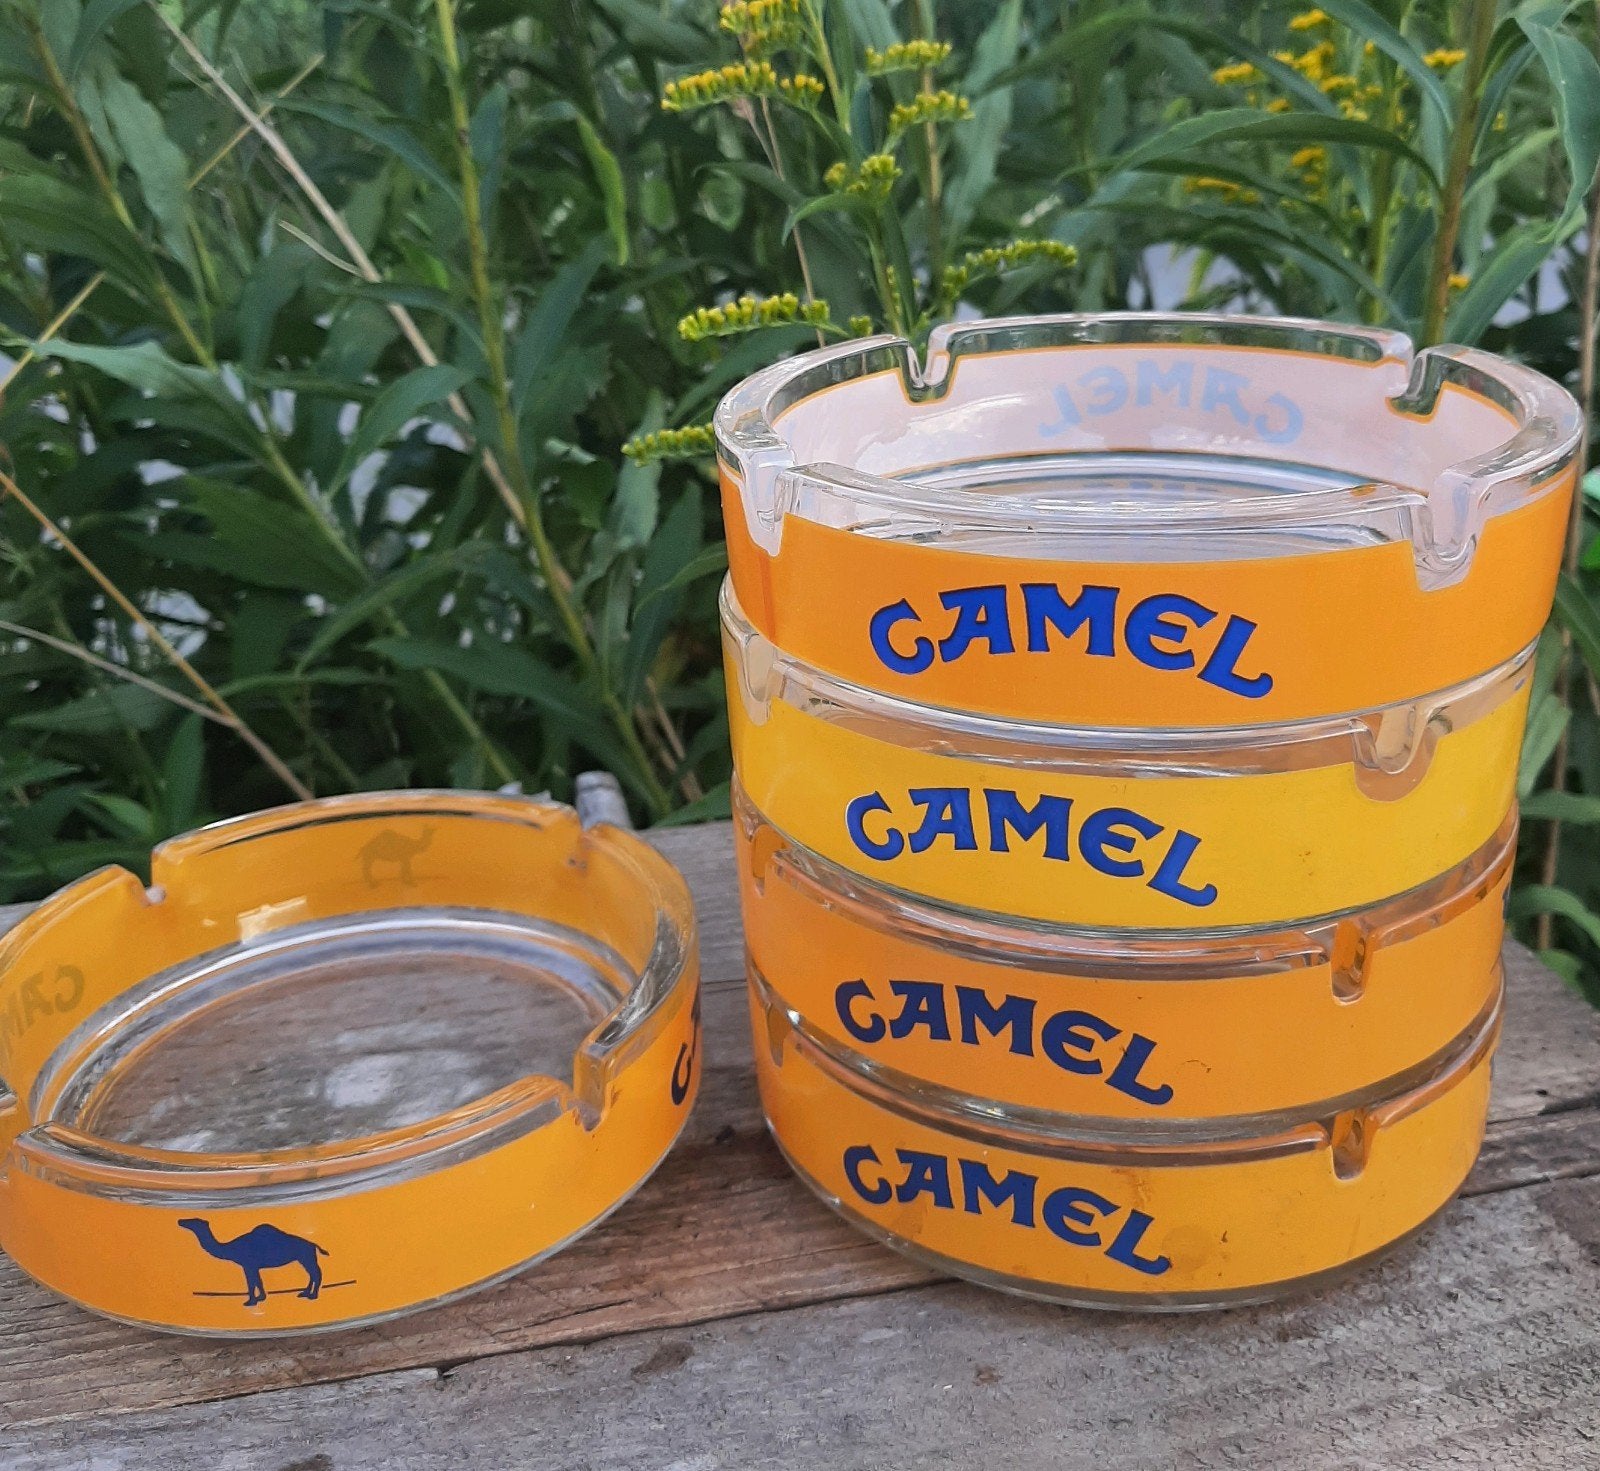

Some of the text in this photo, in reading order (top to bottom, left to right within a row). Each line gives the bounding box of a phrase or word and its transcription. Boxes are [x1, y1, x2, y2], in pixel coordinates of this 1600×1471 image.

[870, 584, 1273, 698] CAMEL
[846, 788, 1217, 905] CAMEL
[835, 980, 1173, 1104] CAMEL
[844, 1145, 1170, 1274] CAMEL
